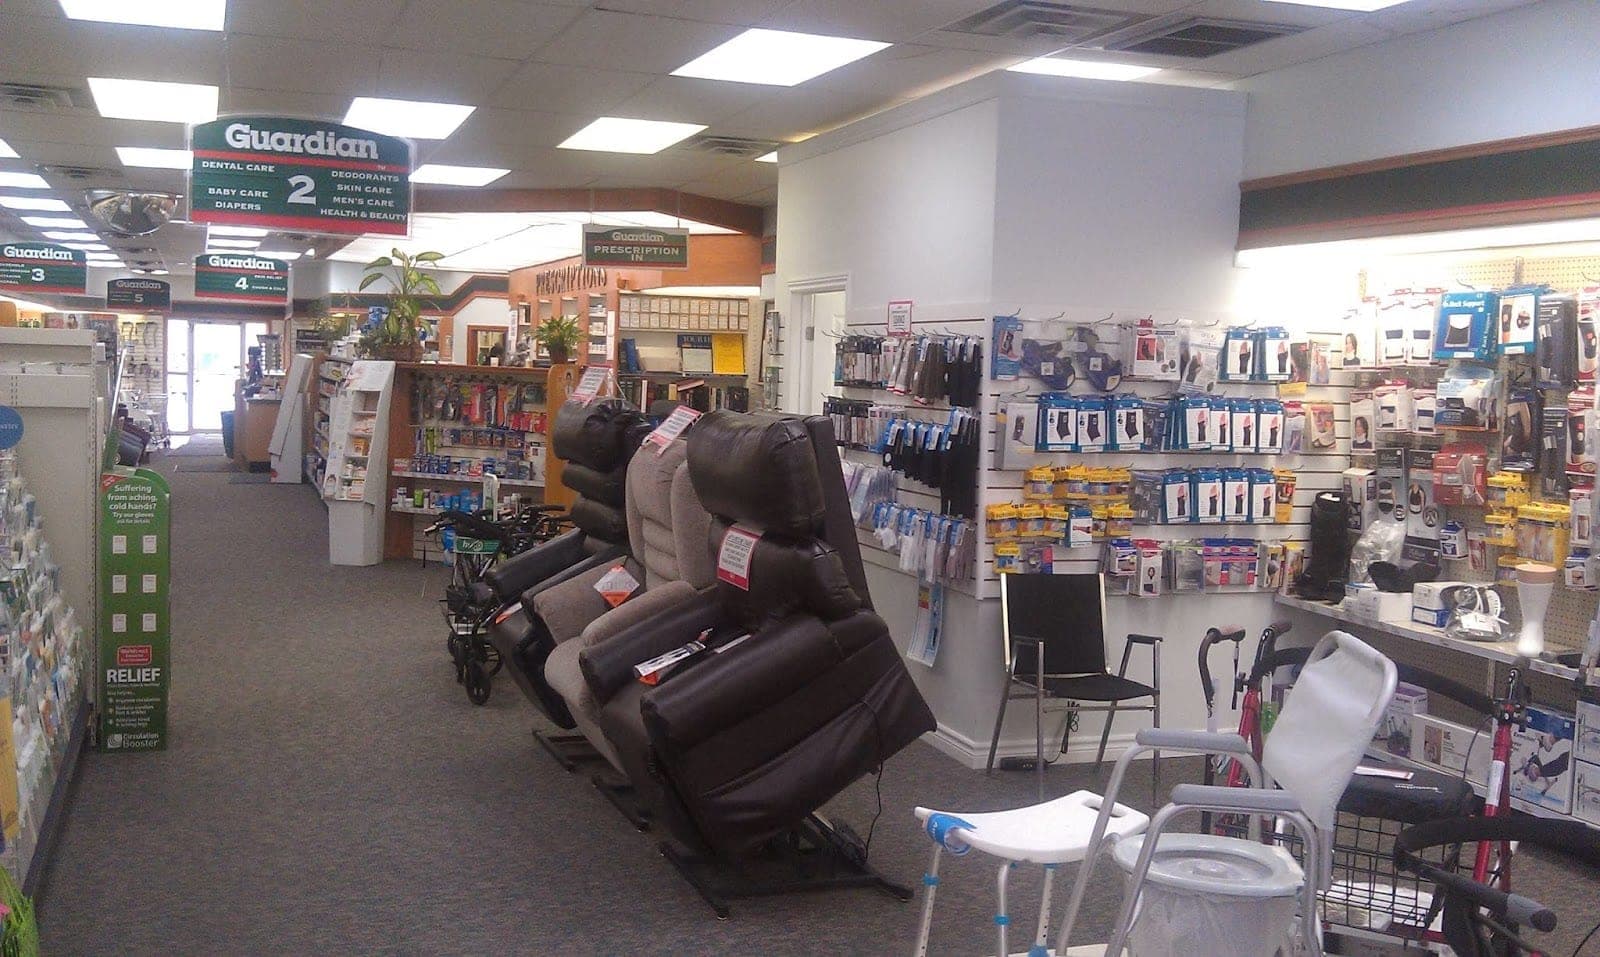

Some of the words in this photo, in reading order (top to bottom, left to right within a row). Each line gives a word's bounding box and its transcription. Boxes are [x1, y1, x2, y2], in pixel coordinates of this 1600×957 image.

[225, 123, 379, 160] Guardian
[202, 161, 243, 171] DENTAL
[246, 164, 275, 172] CARE
[331, 170, 399, 182] DEODORANTS
[208, 187, 237, 196] BABY
[240, 190, 269, 198] CARE
[287, 175, 317, 206] 2
[336, 184, 361, 192] SKIN
[365, 186, 393, 194] CARE
[215, 201, 261, 211] DIAPERS
[332, 196, 364, 205] MEN'S
[367, 199, 395, 207] CARE
[320, 208, 358, 217] HEALTH
[370, 212, 407, 221] BEAUTY
[612, 231, 664, 242] Guardian
[4, 246, 73, 261] Guardian
[594, 245, 679, 255] PRESCRIPTION
[209, 256, 275, 270] Guardian
[31, 267, 45, 281] 3
[116, 281, 161, 289] Guardian
[235, 277, 248, 290] 4
[134, 294, 144, 303] 5
[114, 484, 152, 493] Suffering
[107, 668, 161, 683] RELIEF
[123, 740, 158, 748] Booster
